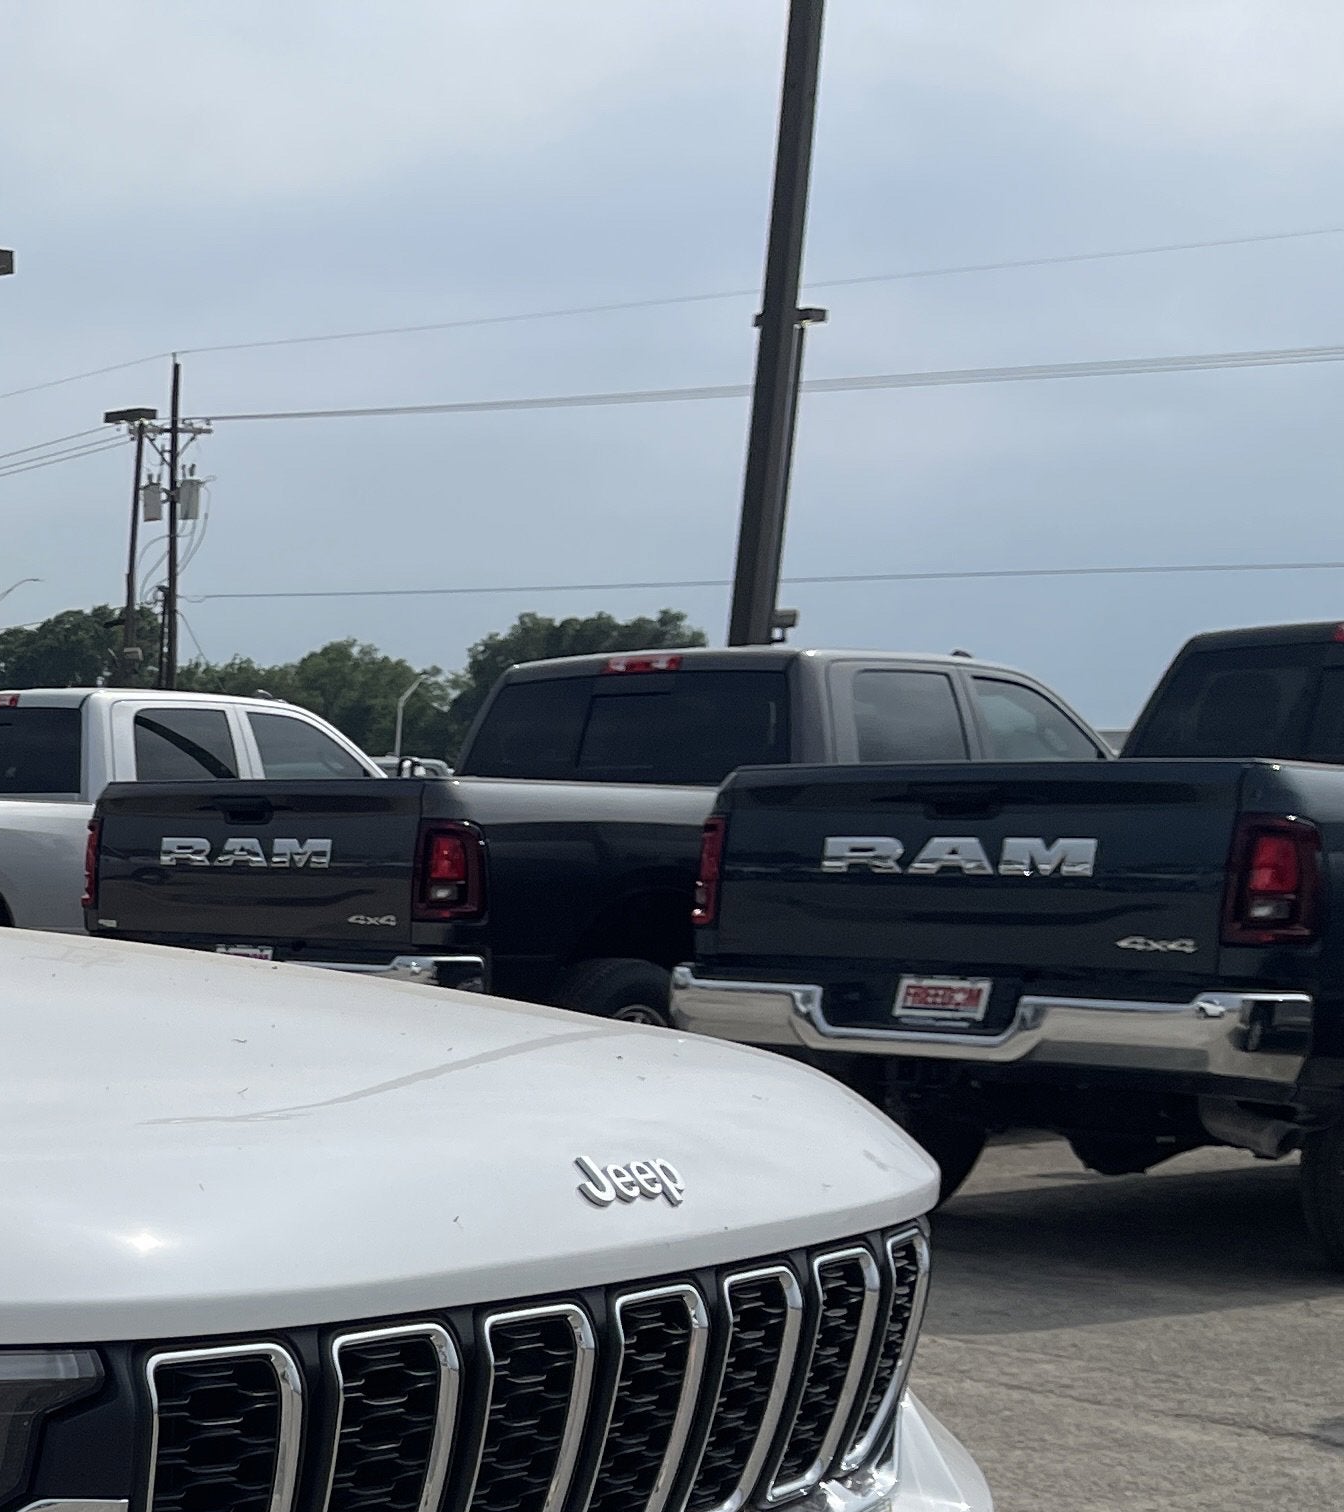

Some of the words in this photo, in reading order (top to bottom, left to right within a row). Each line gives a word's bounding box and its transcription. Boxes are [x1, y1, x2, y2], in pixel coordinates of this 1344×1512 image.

[159, 836, 333, 869] RAM
[821, 836, 1098, 877] RAM
[347, 914, 398, 928] 4x4
[1115, 935, 1198, 954] 4x4
[573, 1155, 687, 1208] Jeep
